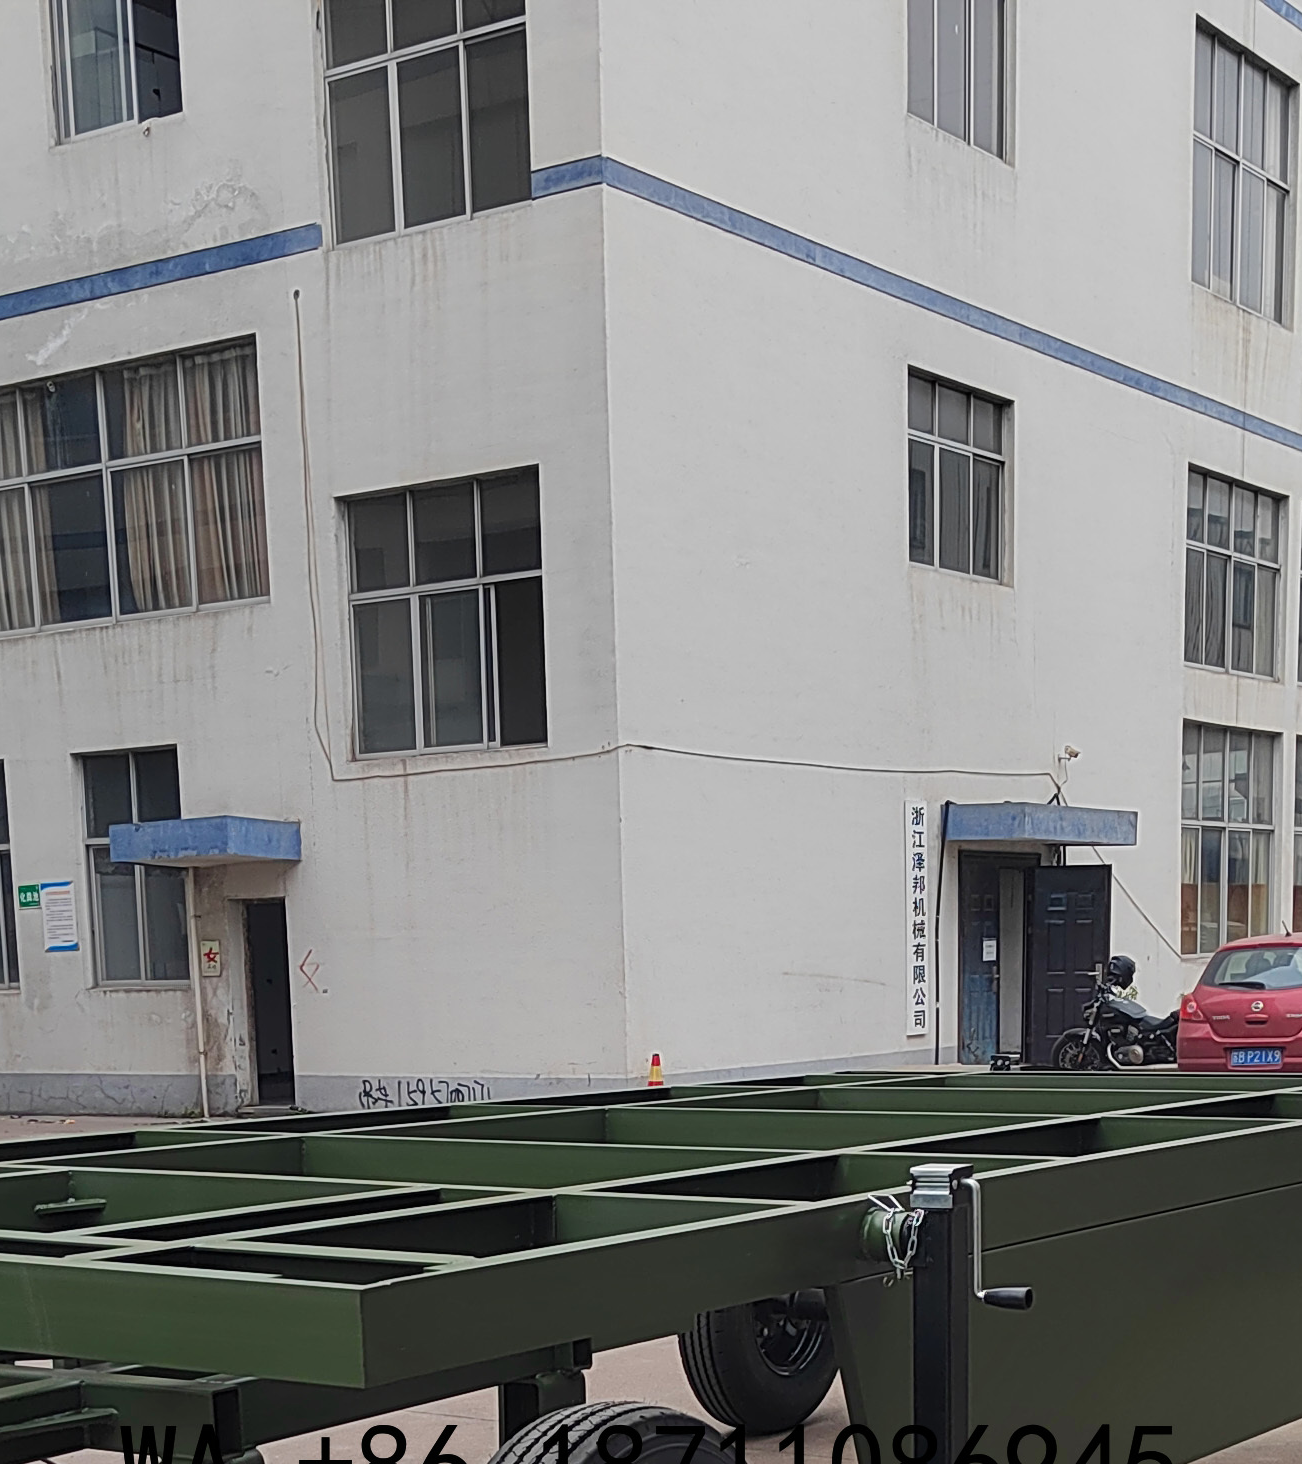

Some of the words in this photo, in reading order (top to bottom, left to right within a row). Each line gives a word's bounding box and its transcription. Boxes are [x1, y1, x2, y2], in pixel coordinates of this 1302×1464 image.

[203, 947, 219, 963] 女
[911, 806, 927, 1029] 浙江泽邦机械有限公司
